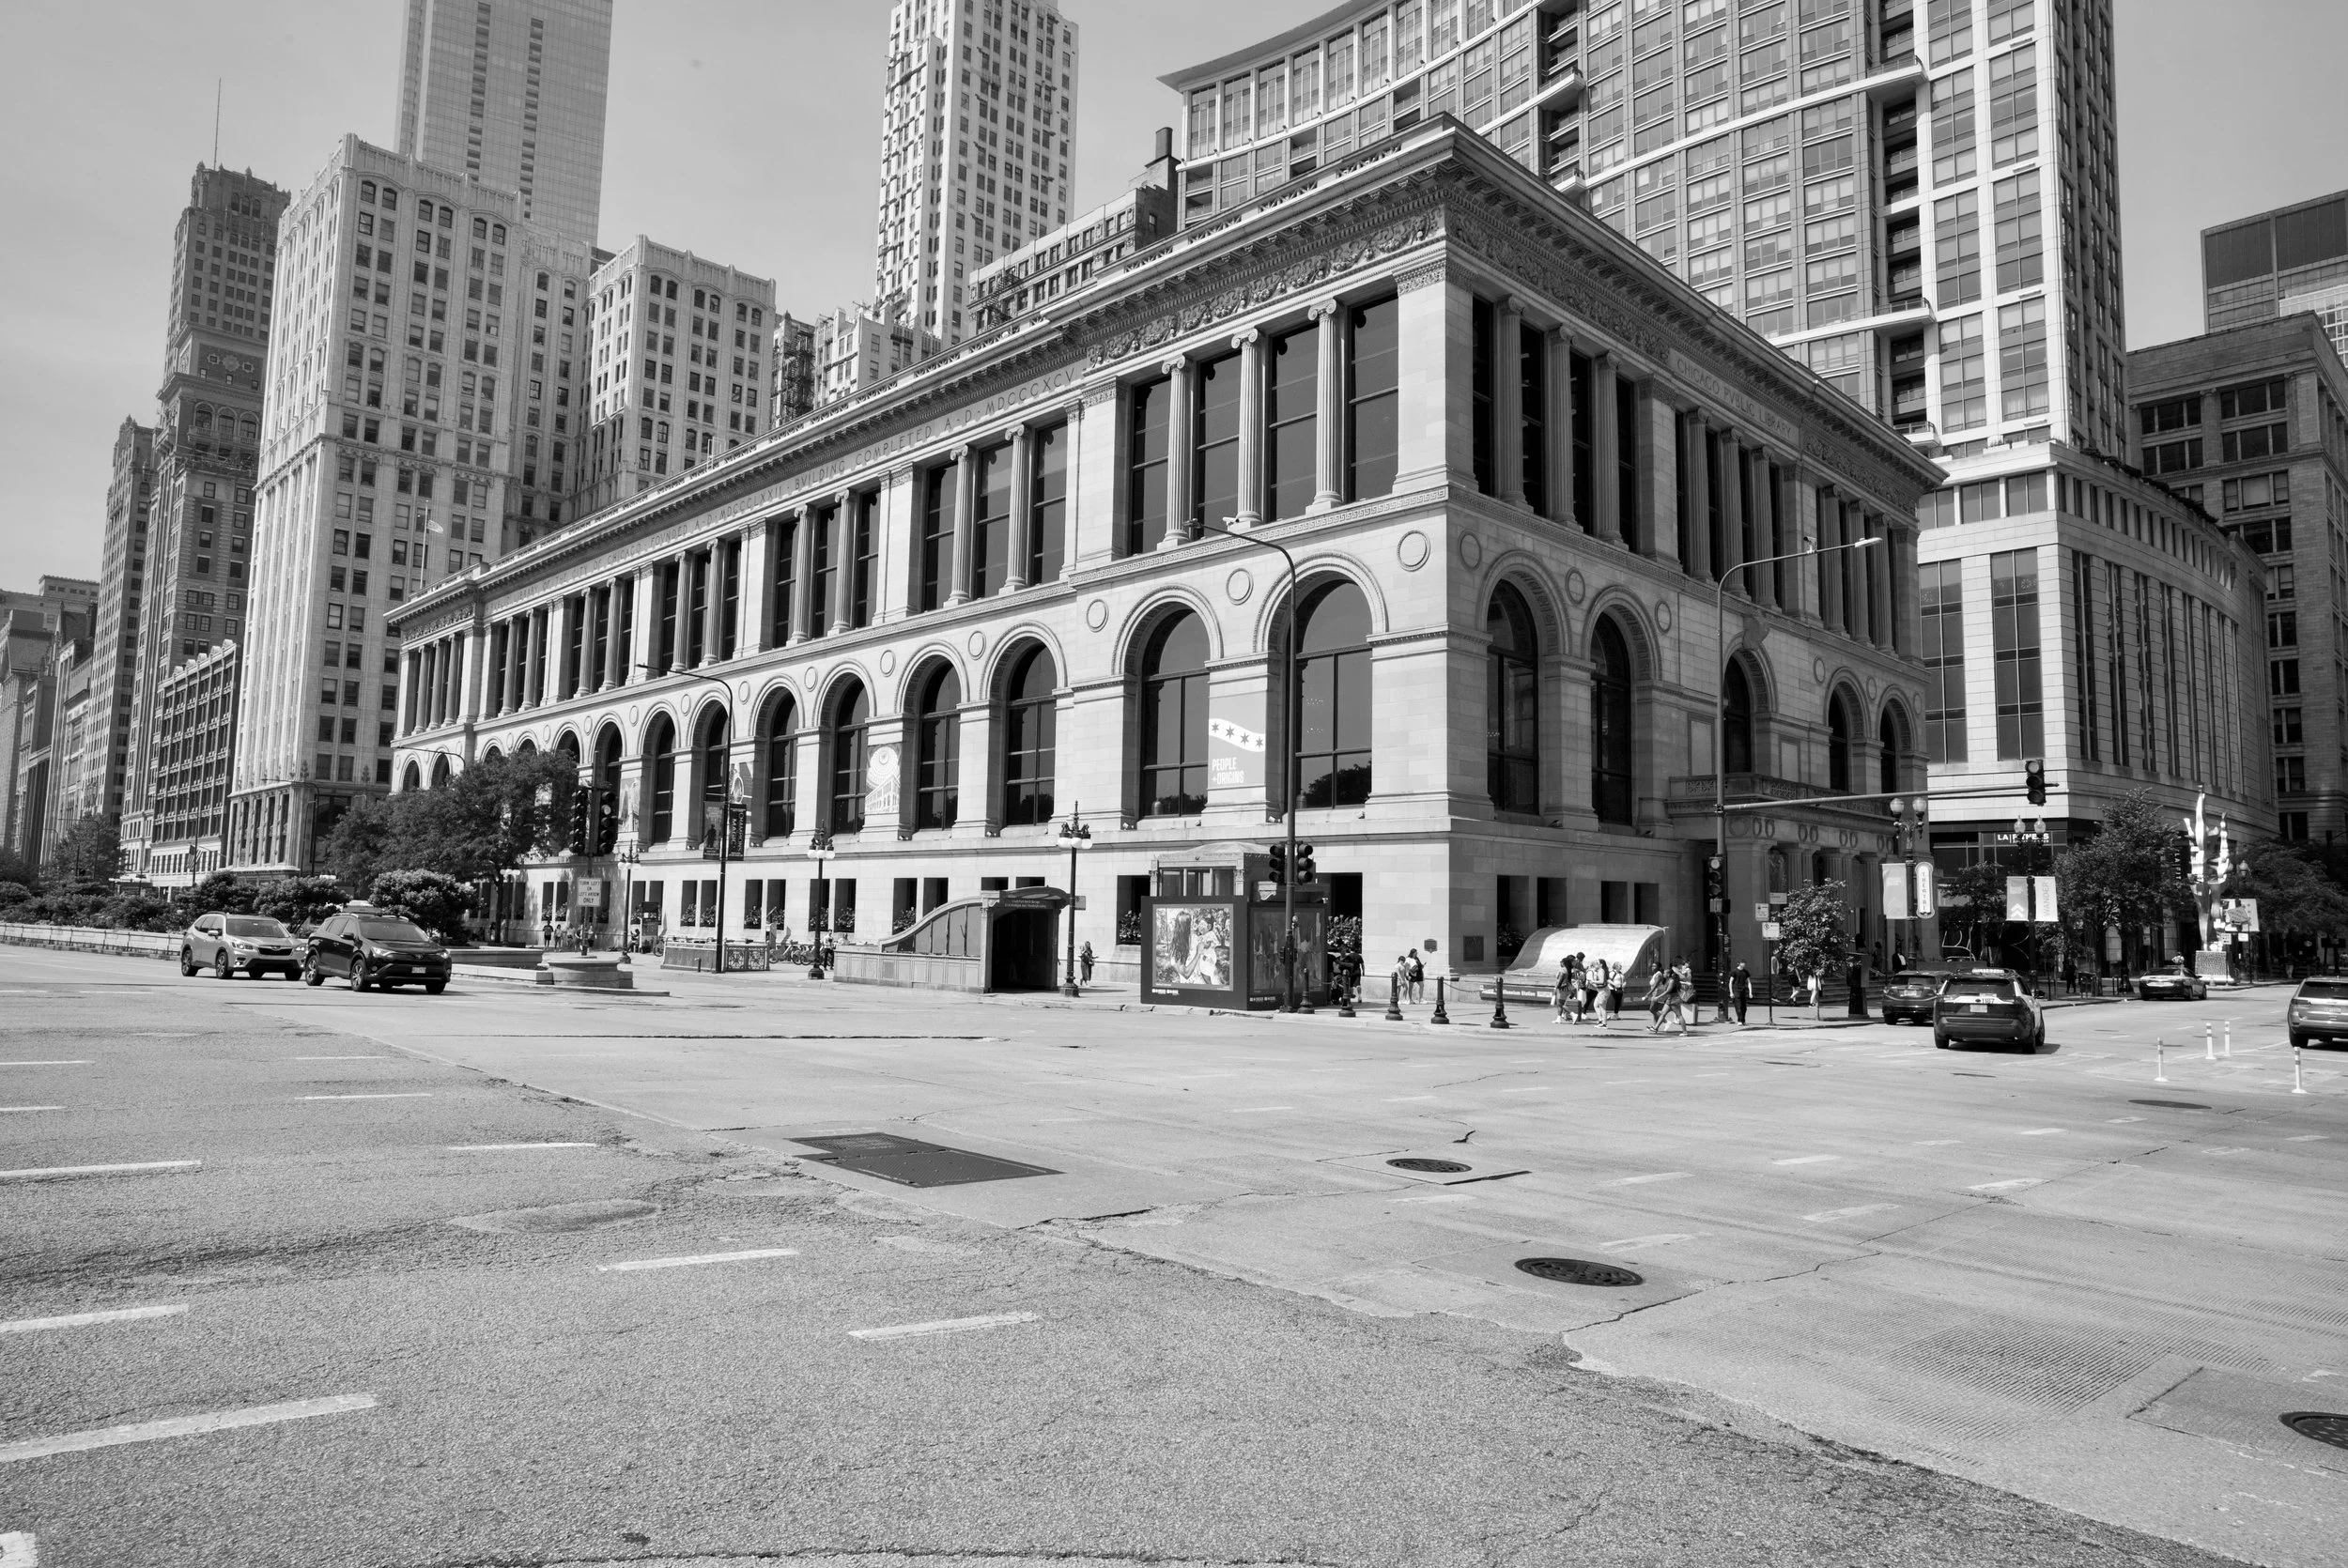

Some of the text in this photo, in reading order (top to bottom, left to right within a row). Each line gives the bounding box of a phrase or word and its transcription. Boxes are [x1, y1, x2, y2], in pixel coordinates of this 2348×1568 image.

[1676, 359, 1792, 440] CHICAGO PVBLIC LIBRARY
[649, 523, 687, 547] FOVNDED
[795, 460, 845, 490] BVILDING
[856, 425, 933, 465] COMPLETED
[1212, 757, 1238, 771] PEOPLE
